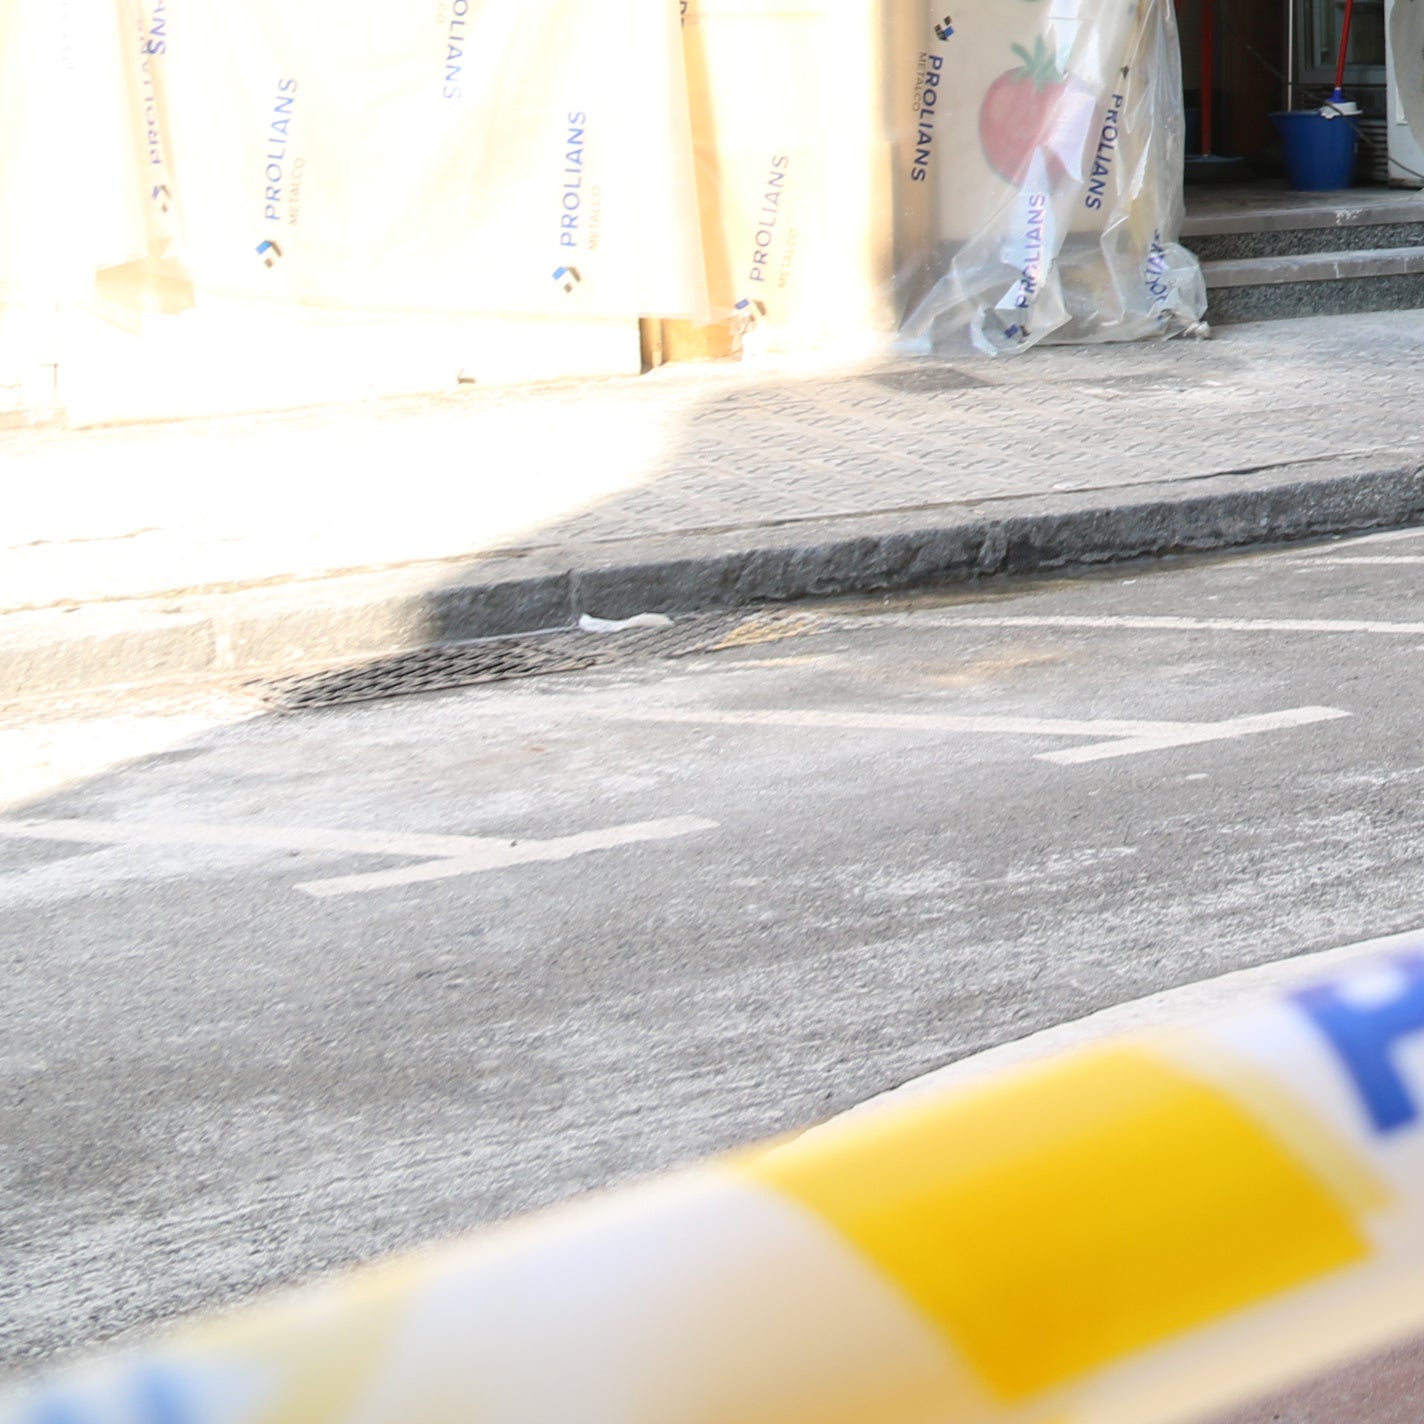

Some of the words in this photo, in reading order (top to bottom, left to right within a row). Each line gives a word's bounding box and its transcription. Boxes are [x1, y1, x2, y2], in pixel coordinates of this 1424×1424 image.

[911, 54, 944, 182] PROLIANS
[912, 50, 929, 112] METALCO
[264, 77, 297, 220] PROLIANS
[289, 156, 306, 226] METALCO
[560, 110, 586, 246] PROLIANS
[1084, 93, 1123, 212] PROLIANS
[588, 185, 601, 250] METALCO
[749, 153, 789, 282] PROLIANS
[777, 227, 798, 288] METALCO
[1014, 193, 1045, 309] PROLIANS
